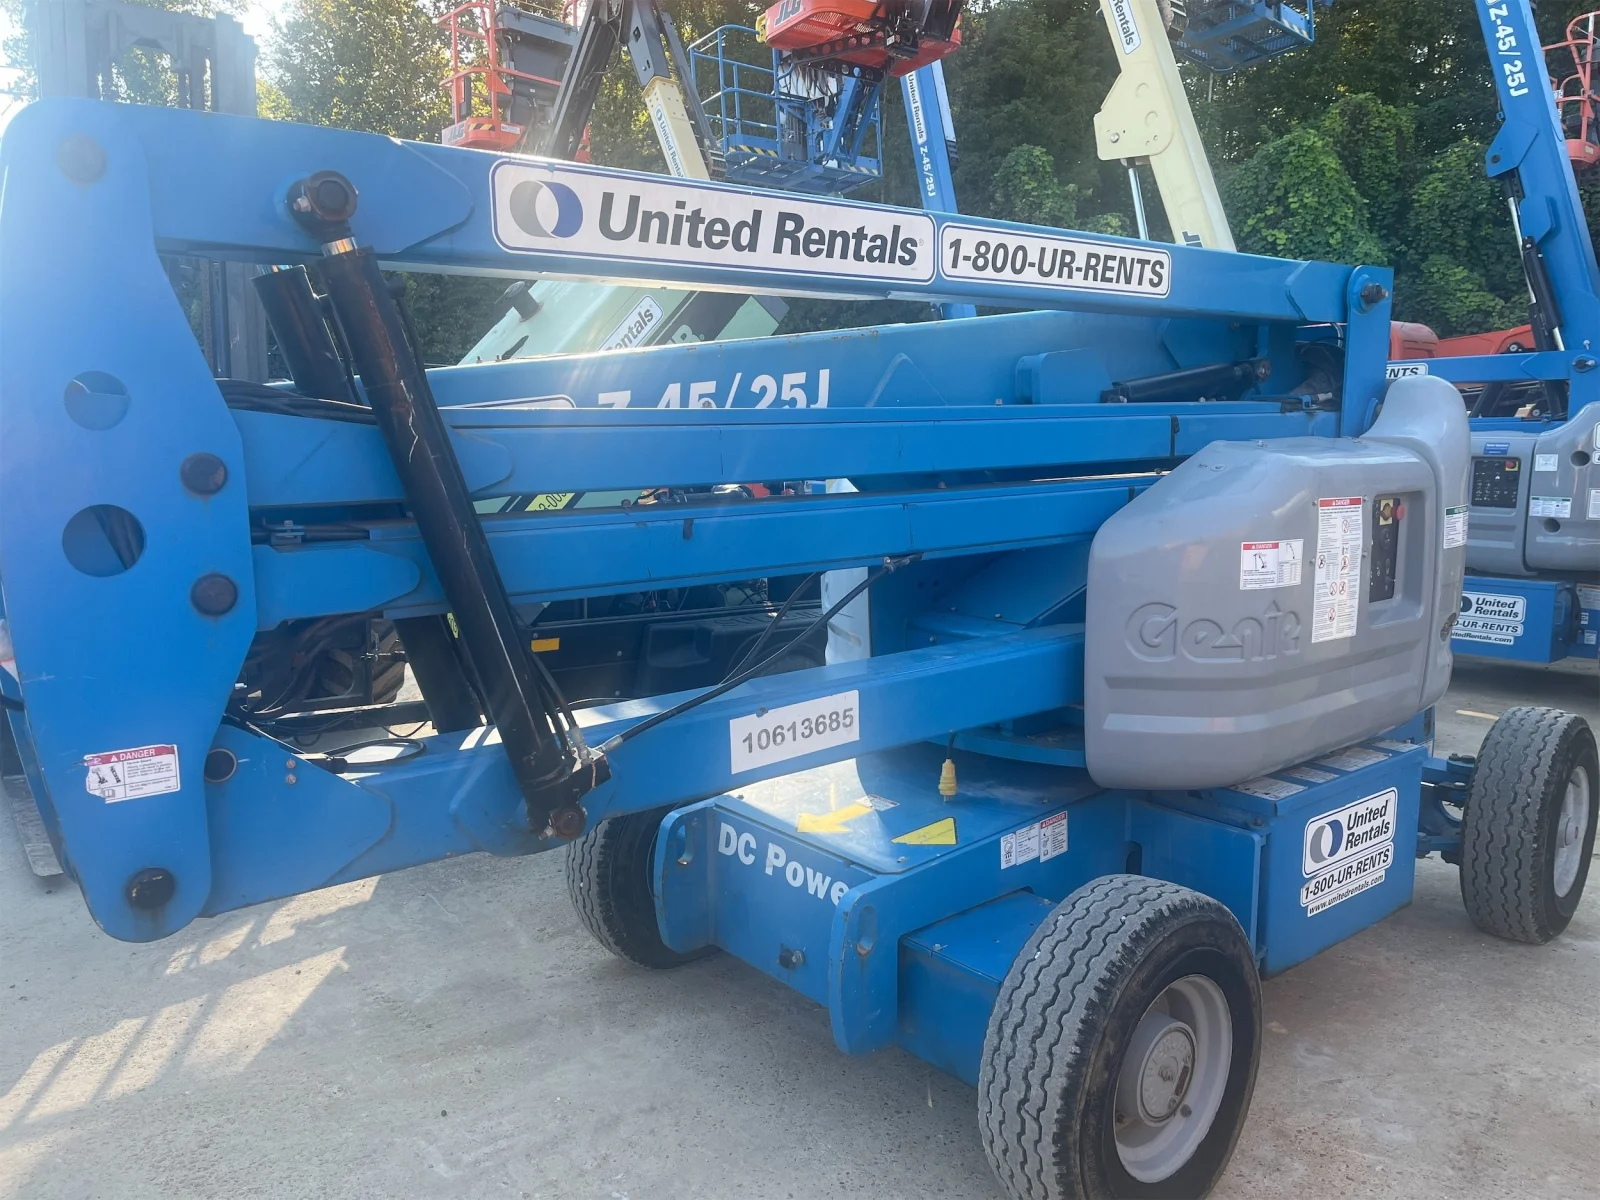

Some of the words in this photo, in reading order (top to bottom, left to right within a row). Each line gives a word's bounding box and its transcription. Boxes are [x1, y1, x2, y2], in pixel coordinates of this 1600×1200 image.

[1113, 0, 1136, 46] Rentals
[1489, 4, 1529, 97] Z-45/25J
[907, 74, 918, 105] United
[914, 106, 924, 139] Rentals
[660, 121, 675, 151] United
[920, 145, 936, 197] Z-45/25J
[599, 192, 763, 253] United
[772, 211, 918, 266] Rentals
[949, 238, 1165, 288] 1-800-UR-RENTS
[1474, 606, 1520, 619] Rentals
[1475, 597, 1516, 609] United
[1125, 600, 1301, 664] Genie
[742, 707, 854, 754] 10613685
[120, 748, 156, 761] DANGER
[1344, 819, 1391, 852] Rentals
[1346, 799, 1389, 831] United
[718, 822, 757, 865] DC
[1304, 848, 1390, 900] 1-800-UR-RENTS
[1309, 874, 1384, 914] www.unitedrentals.com
